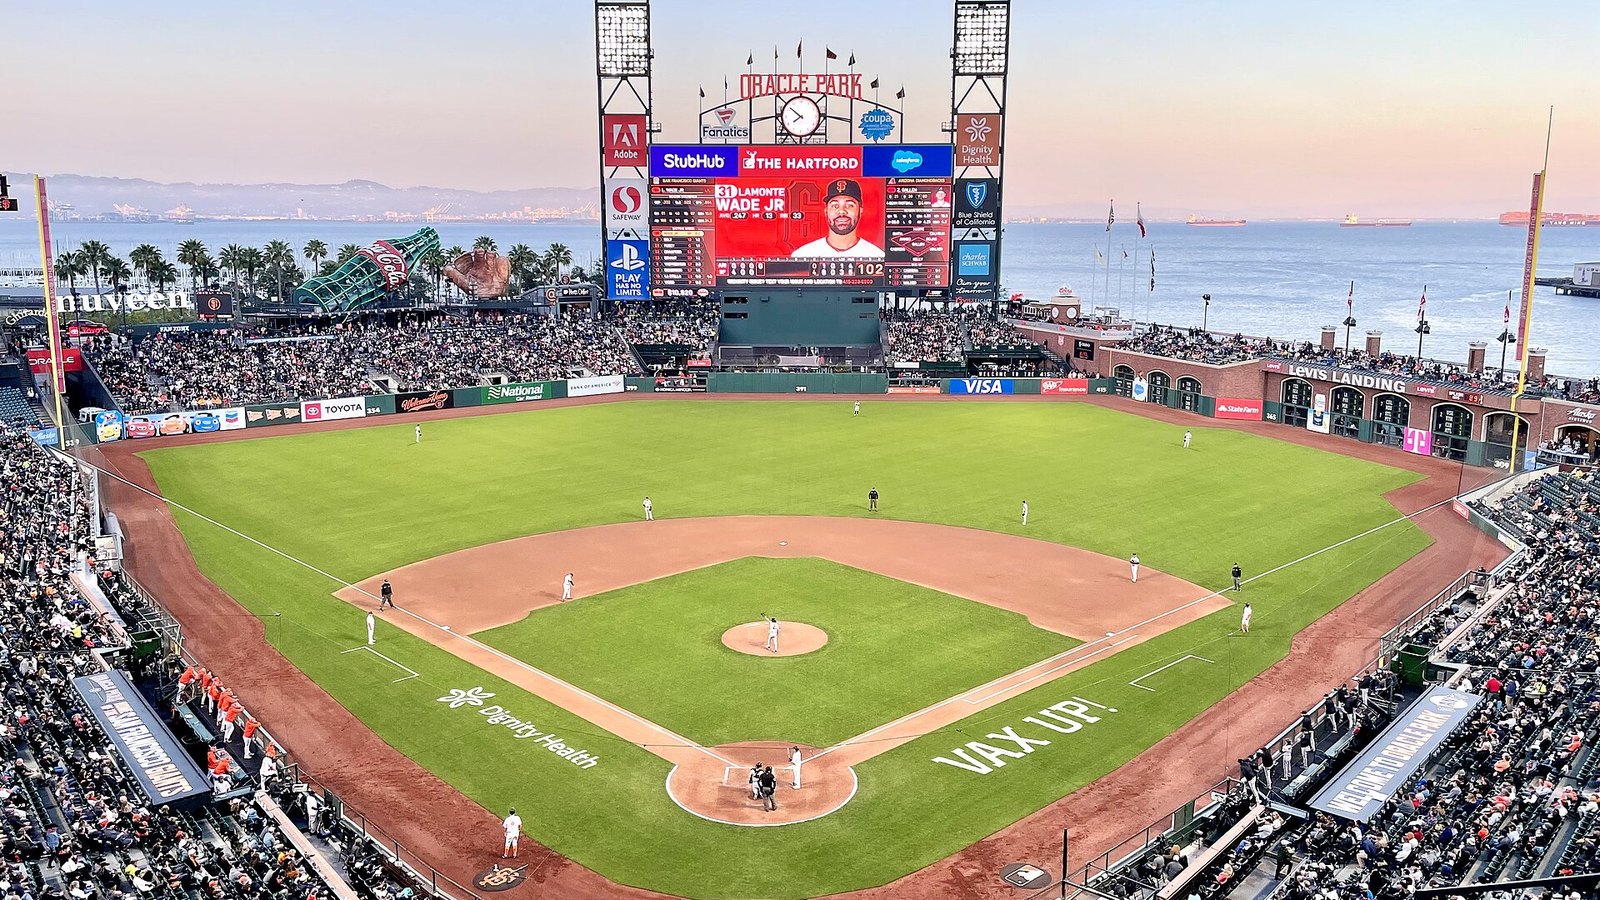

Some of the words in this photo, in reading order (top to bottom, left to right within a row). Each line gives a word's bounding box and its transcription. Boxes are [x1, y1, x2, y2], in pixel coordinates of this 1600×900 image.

[740, 74, 808, 100] ORACLE
[816, 74, 863, 100] PARK
[864, 115, 891, 124] coupa
[702, 126, 748, 138] Fanatics
[614, 150, 638, 158] Adobe
[962, 145, 994, 156] Dignity
[664, 154, 724, 168] StubHub
[756, 158, 781, 168] THE
[786, 158, 858, 168] HARTFORD
[718, 186, 732, 196] 31
[738, 188, 785, 196] LAMONTE
[716, 198, 760, 211] WADE
[764, 198, 784, 211] JR
[858, 264, 883, 275] 102
[616, 274, 641, 282] PLAY
[57, 292, 194, 314] nuveen
[962, 380, 1002, 393] VISA
[1332, 371, 1406, 393] LANDING
[501, 384, 543, 397] National
[402, 396, 431, 410] Welcome
[429, 391, 448, 401] Home
[325, 403, 362, 414] TOYOTA
[1567, 408, 1596, 419] Alaska
[1409, 710, 1451, 734] PARK
[478, 705, 544, 738] Dignity
[533, 734, 600, 769] Health
[931, 726, 1052, 775] VAX
[1022, 696, 1118, 734] UP!
[1381, 726, 1433, 763] ORACLE
[1369, 756, 1406, 772] TO
[144, 763, 193, 798] GIANTS
[1326, 764, 1396, 814] WELCOME
